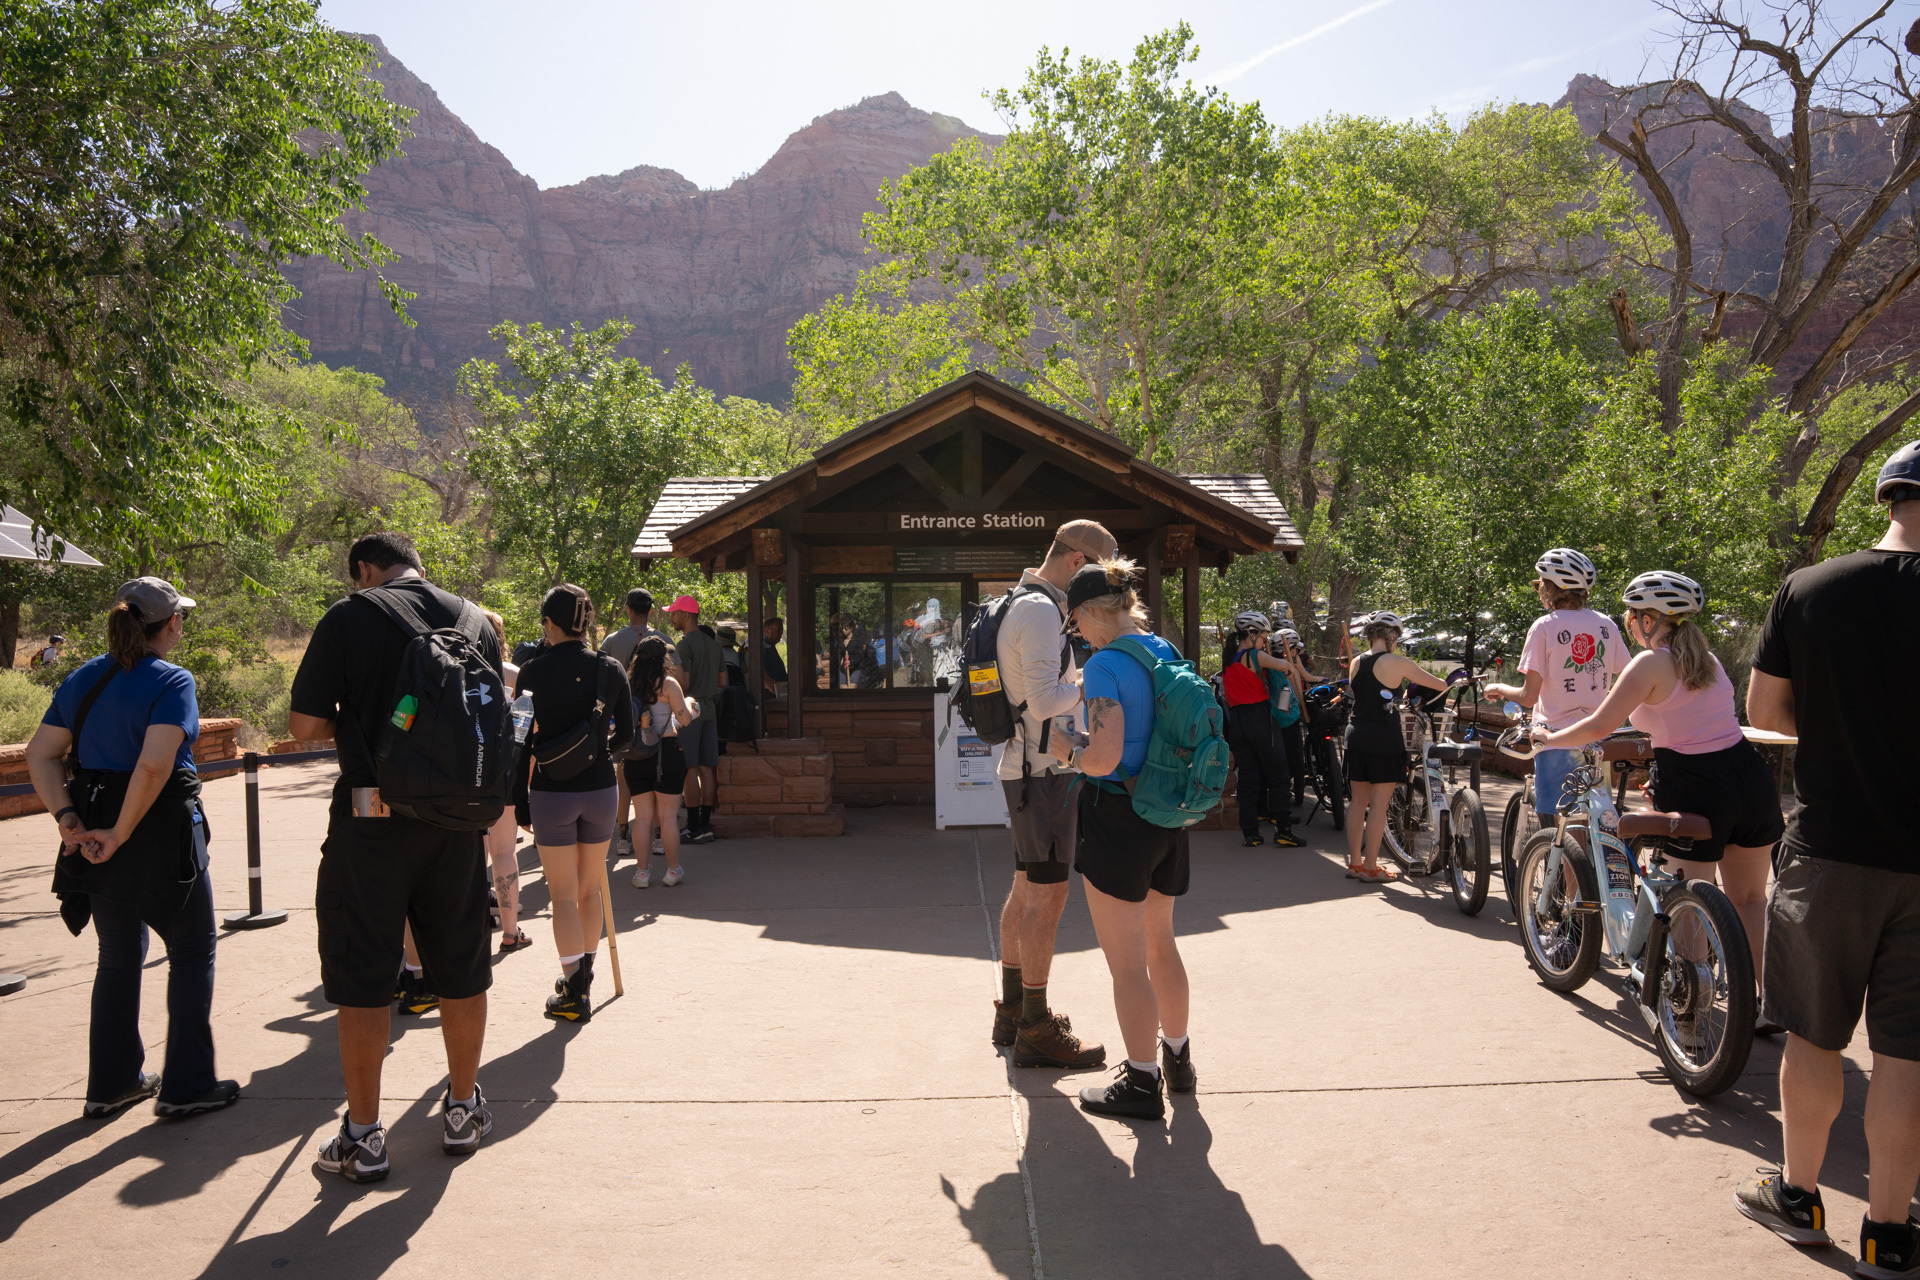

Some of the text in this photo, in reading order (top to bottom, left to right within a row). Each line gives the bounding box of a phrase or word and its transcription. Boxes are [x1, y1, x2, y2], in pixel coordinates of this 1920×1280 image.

[900, 512, 1046, 529] Entrance Station
[1557, 629, 1572, 645] O
[1563, 677, 1576, 693] E
[475, 712, 485, 744] UNDER
[475, 744, 484, 788] ARMOUR
[1600, 835, 1617, 846] RENT
